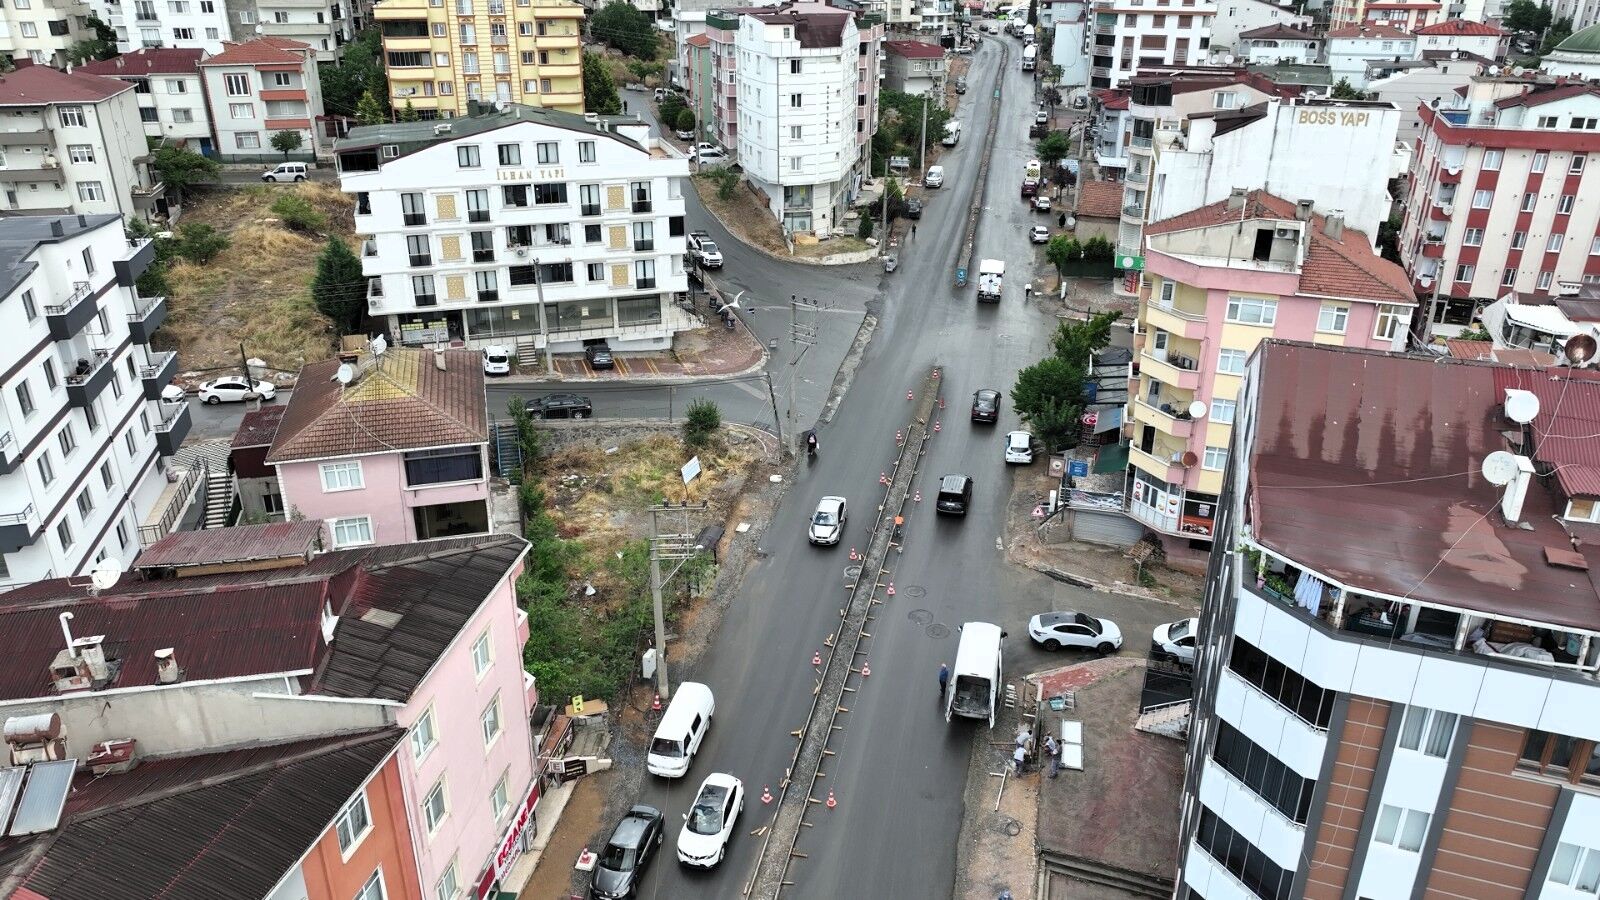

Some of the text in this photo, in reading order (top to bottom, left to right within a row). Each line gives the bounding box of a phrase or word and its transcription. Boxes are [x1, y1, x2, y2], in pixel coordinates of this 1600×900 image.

[1299, 110, 1369, 127] BOSS YAPI
[540, 169, 564, 178] YAPI
[497, 807, 528, 868] ECZANE
